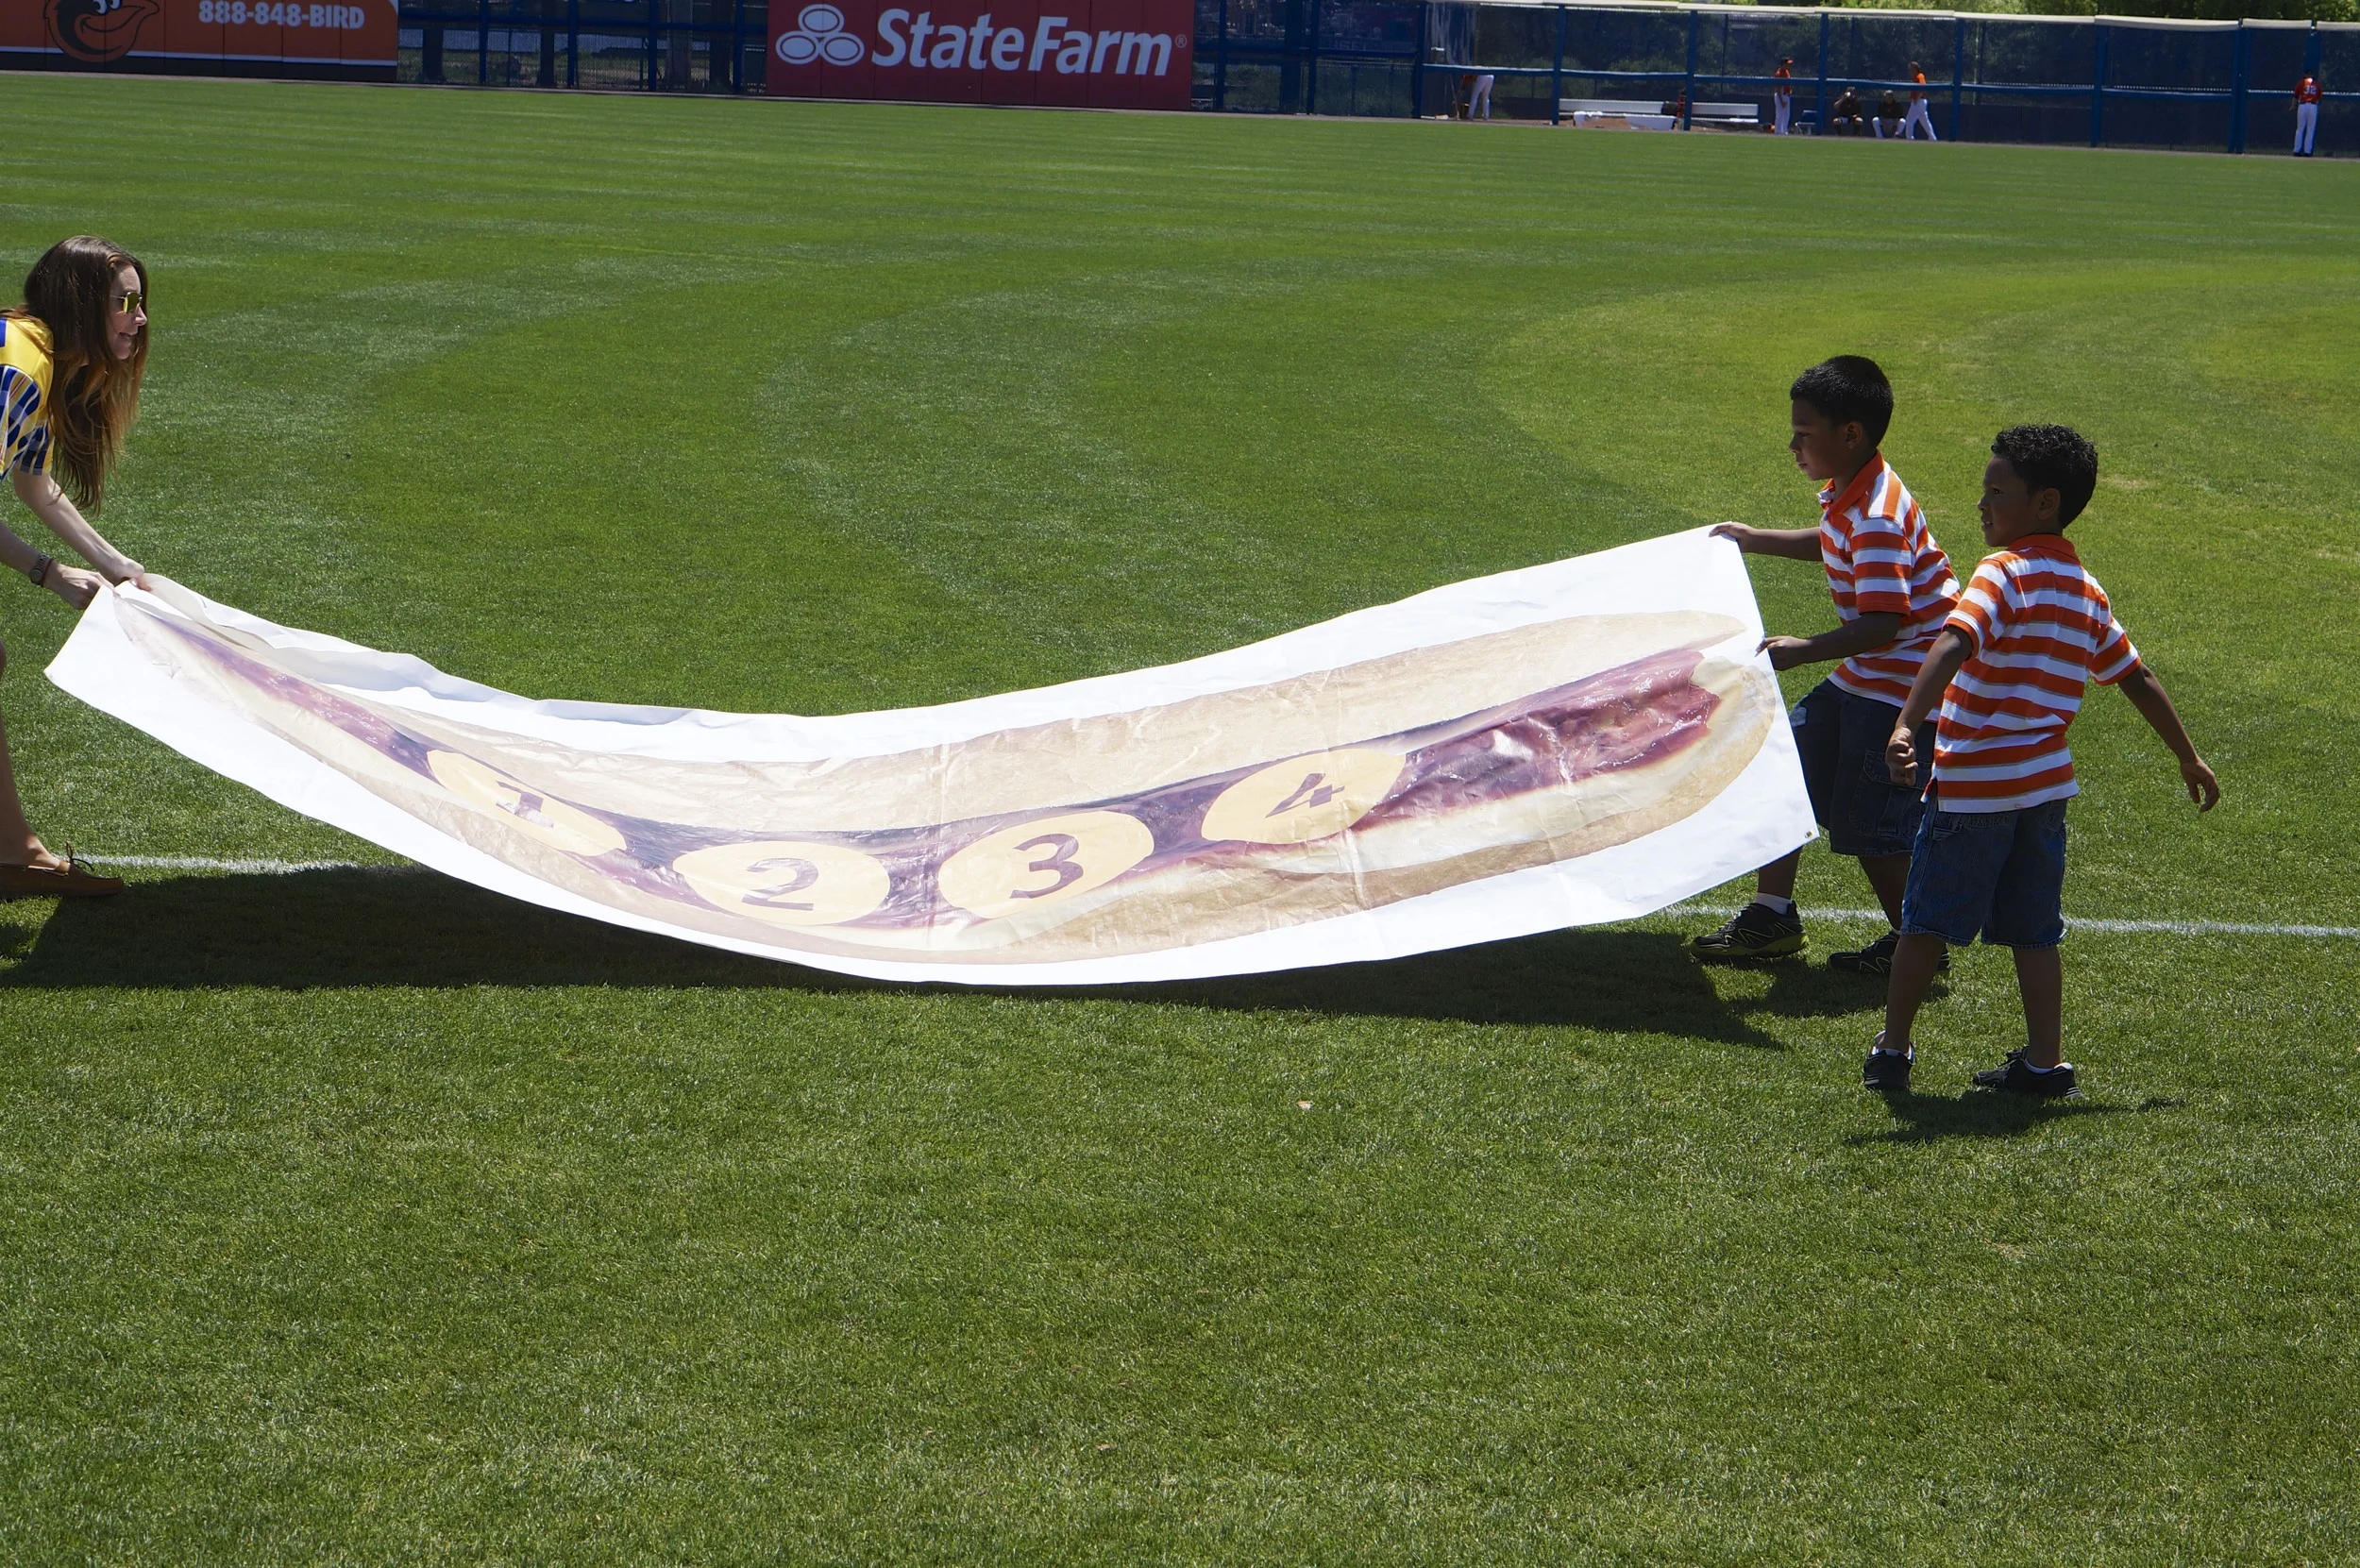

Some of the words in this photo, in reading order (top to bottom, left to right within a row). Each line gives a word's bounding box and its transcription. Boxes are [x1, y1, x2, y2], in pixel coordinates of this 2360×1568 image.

[198, 0, 365, 29] 888-848-BIRD
[1265, 772, 1345, 818] 4
[741, 857, 819, 912] 2
[1010, 833, 1085, 900] 3
